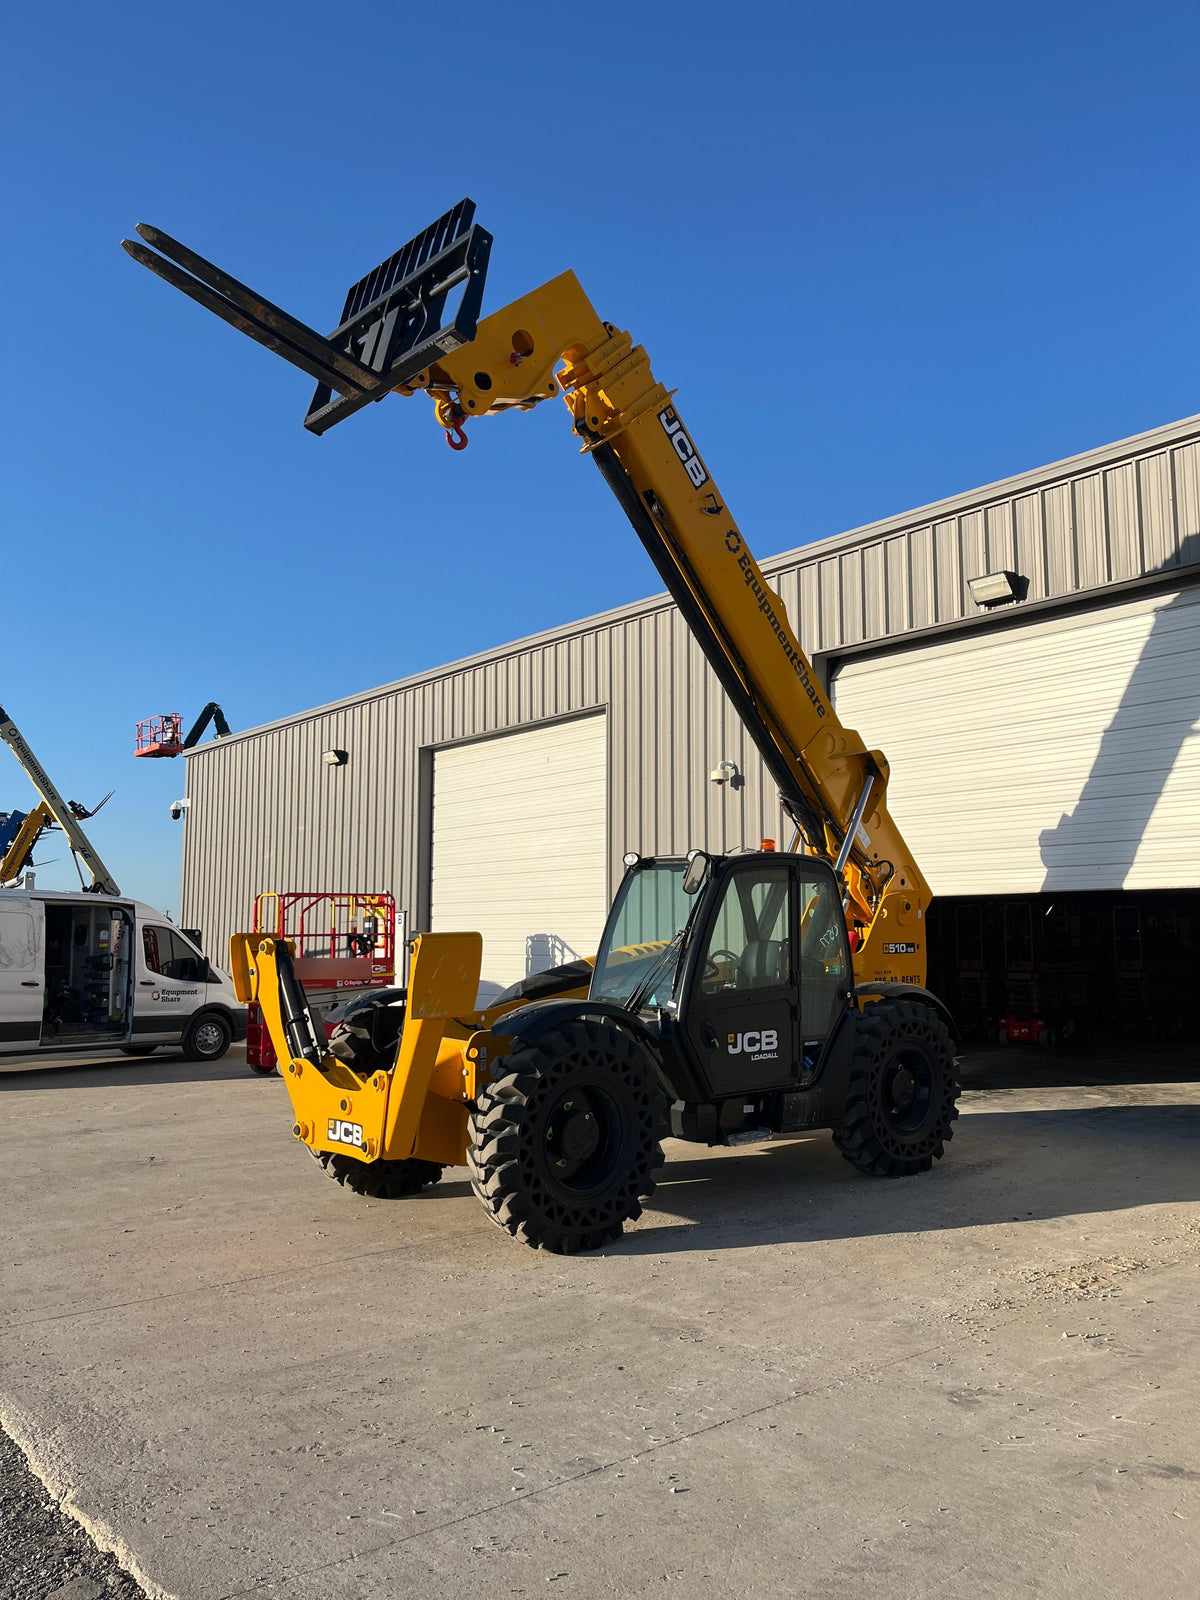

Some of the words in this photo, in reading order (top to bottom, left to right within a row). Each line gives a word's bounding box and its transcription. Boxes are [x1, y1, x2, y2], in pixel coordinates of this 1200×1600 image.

[660, 408, 707, 487] JCB
[737, 552, 826, 718] EquipmentShare
[14, 737, 57, 800] EquipmentShare
[79, 846, 91, 860] JLG
[728, 1030, 778, 1054] JCB
[751, 1053, 778, 1061] LOADALL
[328, 1119, 363, 1147] JCB
